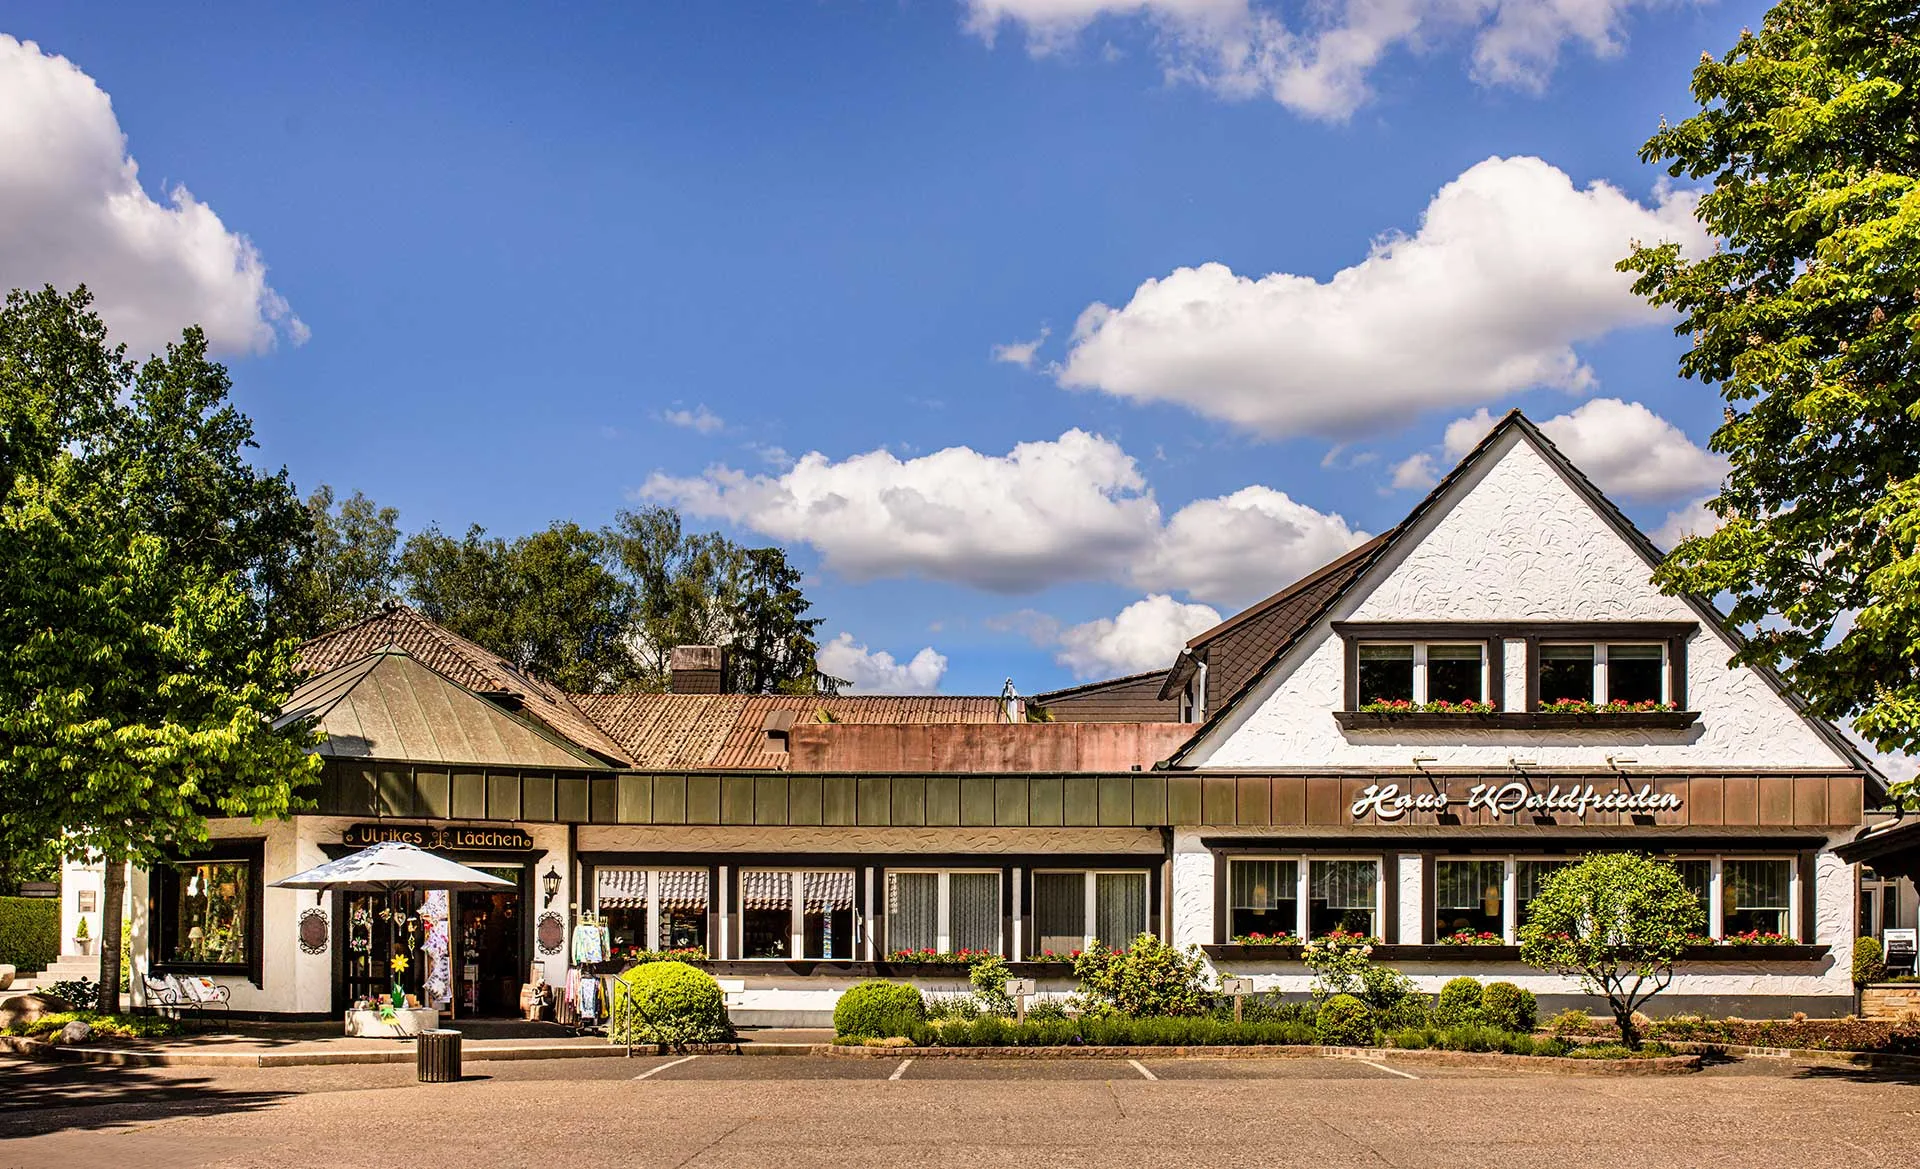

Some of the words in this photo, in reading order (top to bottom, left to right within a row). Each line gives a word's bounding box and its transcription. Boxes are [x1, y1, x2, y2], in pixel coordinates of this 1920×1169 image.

[1352, 784, 1448, 817] Haus
[1468, 782, 1682, 817] Waldfrieden
[361, 828, 423, 844] Ulrikes
[457, 830, 522, 847] Lädchen
